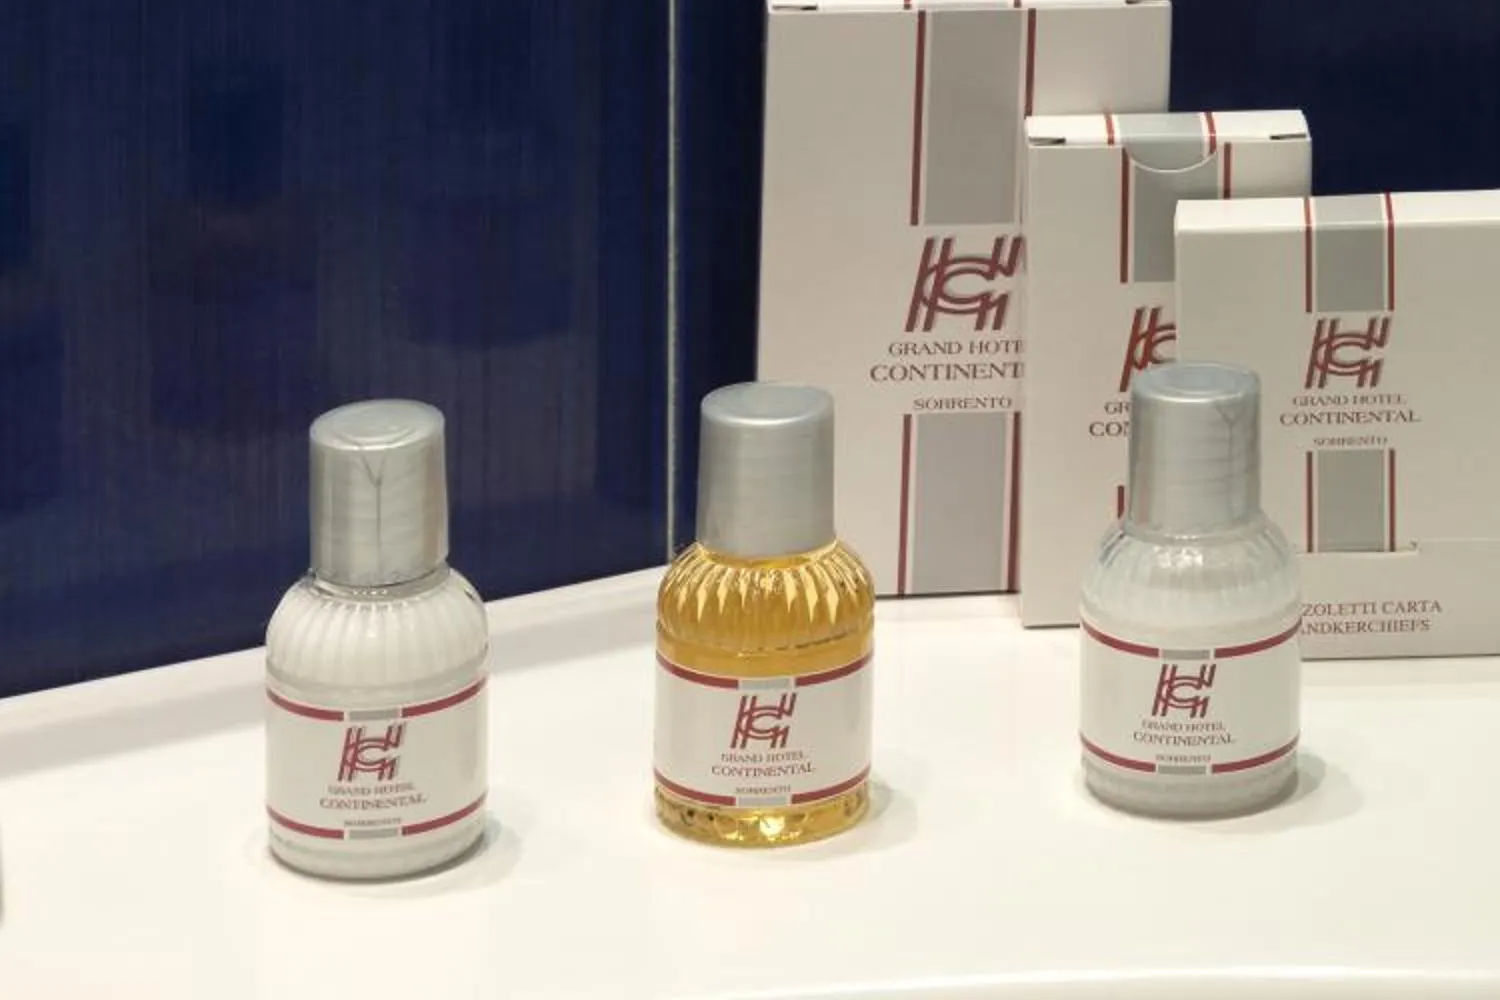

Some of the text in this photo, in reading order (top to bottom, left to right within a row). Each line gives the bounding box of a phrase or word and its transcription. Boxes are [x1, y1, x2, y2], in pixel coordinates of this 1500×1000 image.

[888, 341, 963, 356] GRAND
[913, 397, 1012, 410] SORRENTO
[1292, 393, 1407, 406] GRAND HOTEL
[1280, 409, 1421, 426] CONTINENTAL
[1381, 600, 1442, 615] CARTA
[1133, 731, 1236, 746] CONTINENTAL
[711, 762, 814, 777] CONTINENTAL
[320, 793, 427, 810] CONTINENTAL
